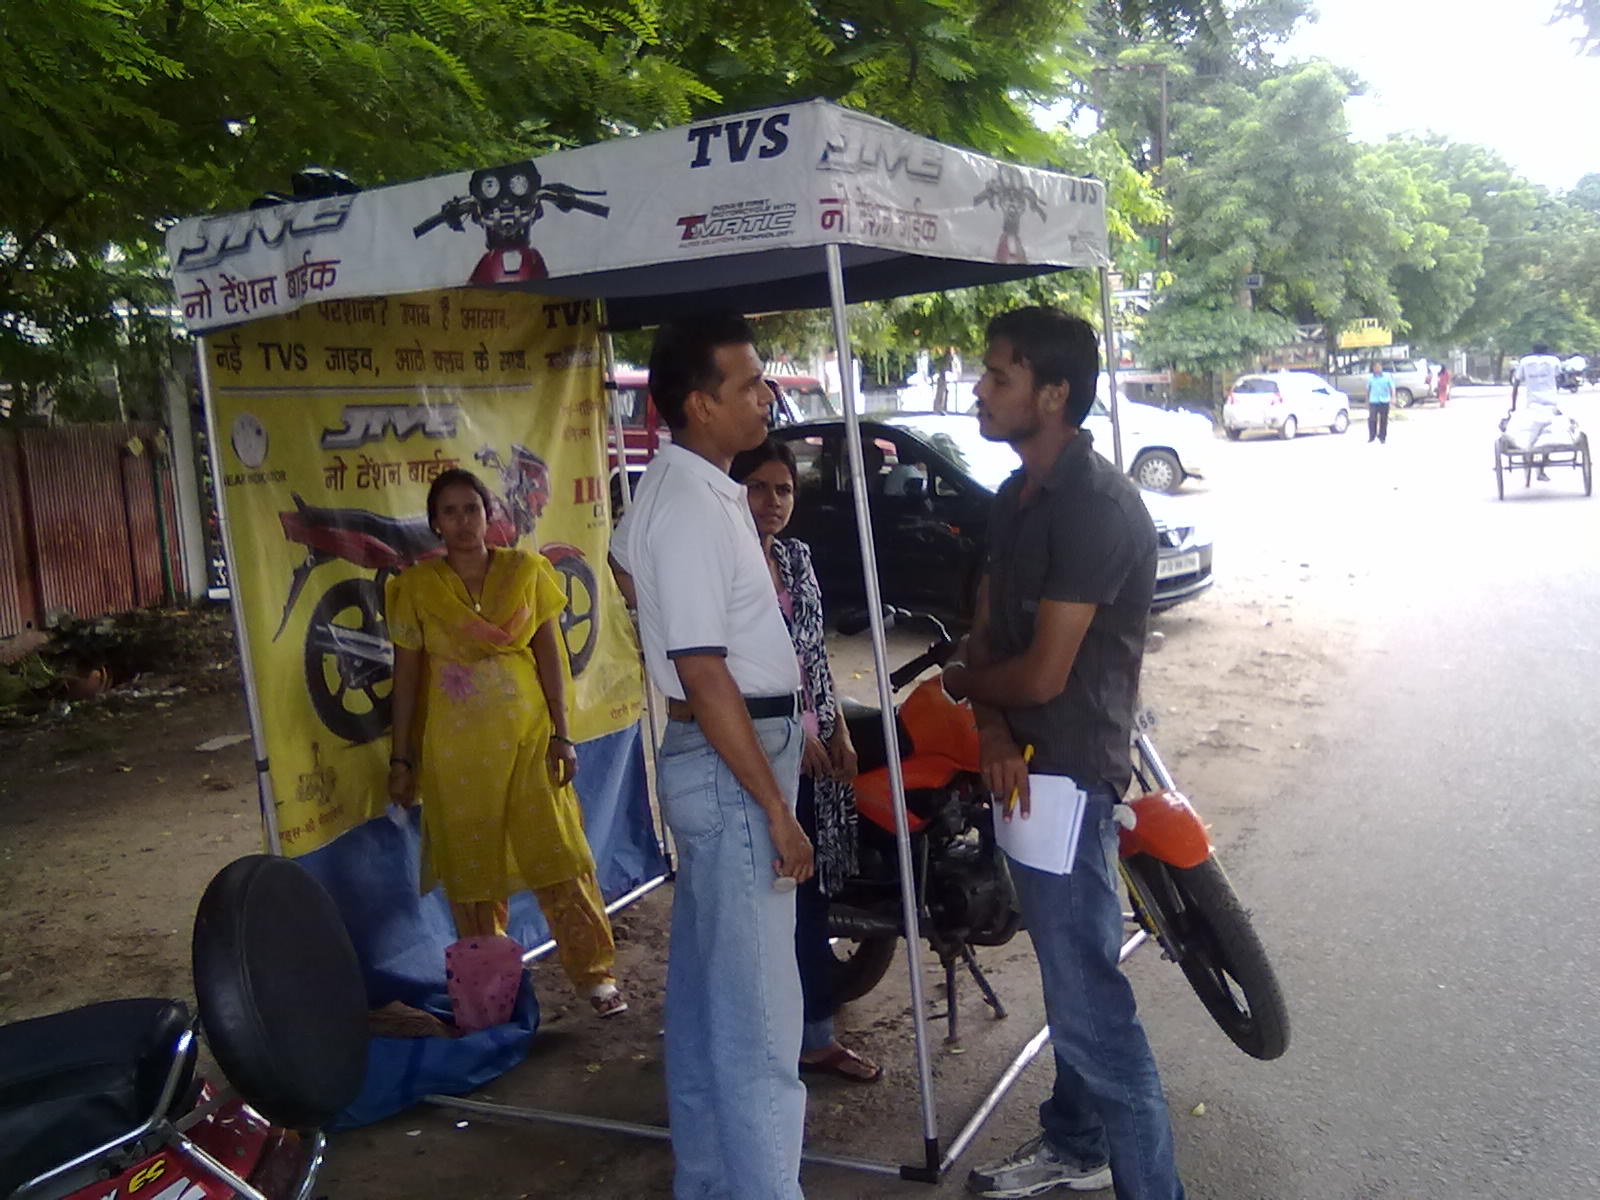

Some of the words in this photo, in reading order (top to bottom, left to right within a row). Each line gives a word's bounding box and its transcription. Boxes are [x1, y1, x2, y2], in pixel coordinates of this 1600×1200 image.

[688, 113, 790, 169] TVS
[1070, 180, 1097, 204] TVS
[181, 280, 213, 320] नो
[220, 272, 277, 314] टेंशन
[286, 249, 341, 299] बाईक
[543, 300, 591, 328] TVS
[213, 333, 242, 375] नई
[258, 342, 308, 371] TVS
[324, 347, 381, 377] जाइव,
[473, 342, 489, 373] के
[323, 456, 348, 490] नो
[356, 454, 402, 490] टेंशन
